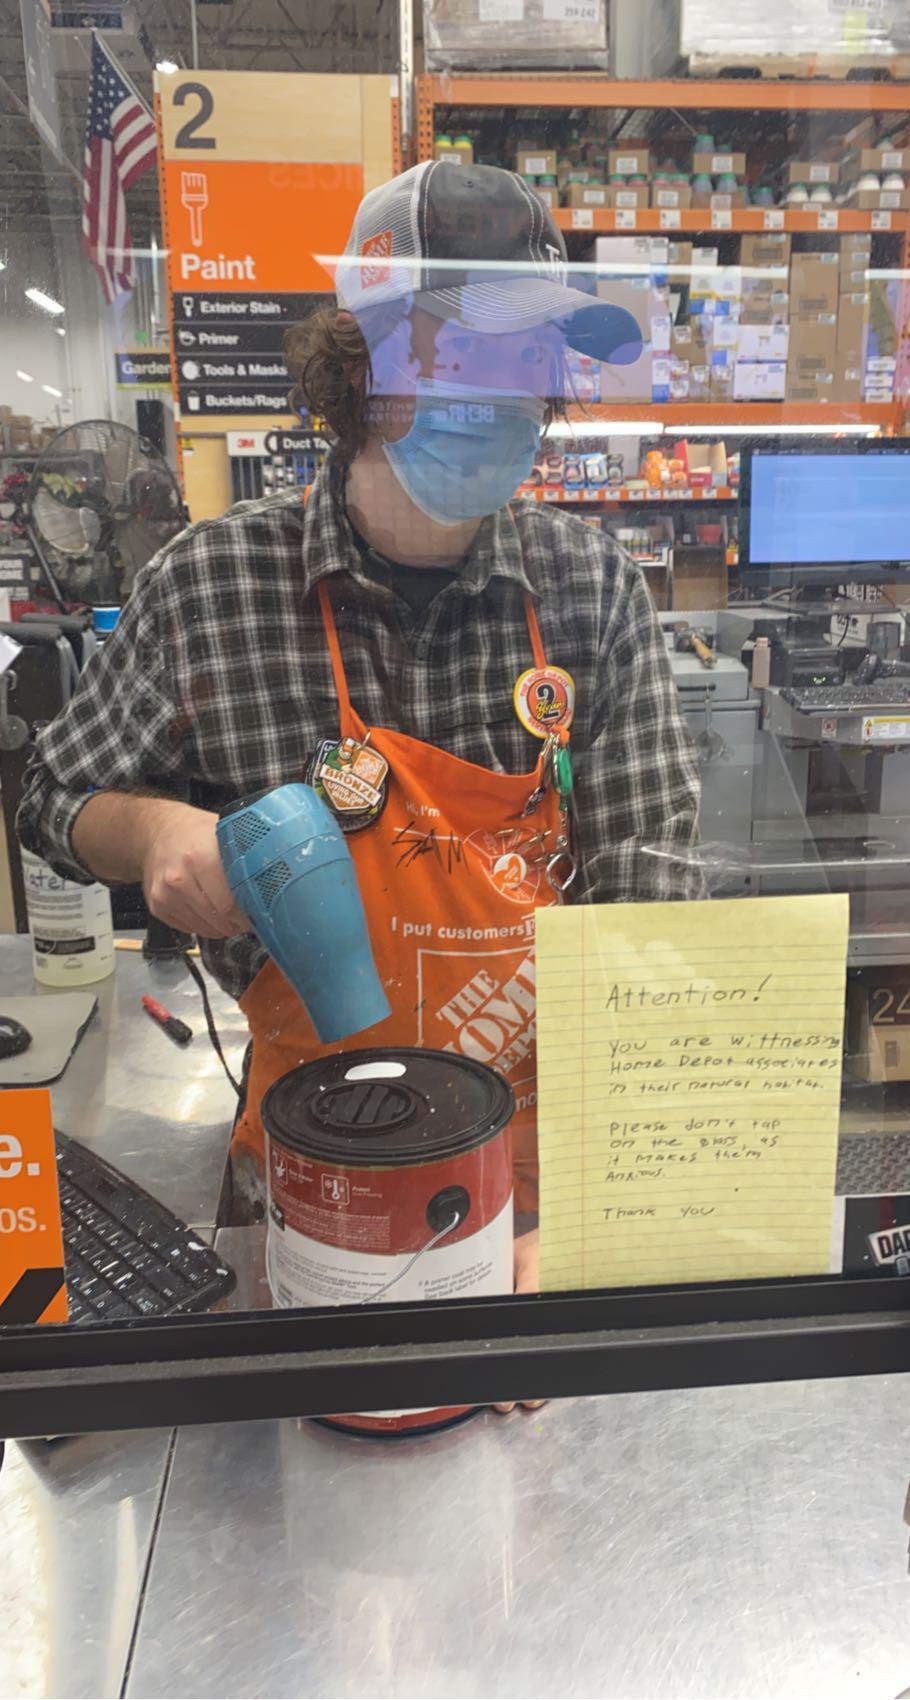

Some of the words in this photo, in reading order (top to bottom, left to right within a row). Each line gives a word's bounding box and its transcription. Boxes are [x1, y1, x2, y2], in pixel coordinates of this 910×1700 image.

[172, 81, 217, 150] 2
[180, 253, 256, 281] Paint
[200, 301, 248, 314] Exterior
[249, 301, 281, 314] Stain
[198, 332, 239, 345] Primer
[203, 364, 235, 376] Tools
[237, 364, 246, 376] &
[248, 364, 288, 376] Masks
[205, 395, 287, 409] Buckets/Rags
[236, 438, 256, 449] 3M
[283, 438, 311, 449] Duct
[420, 805, 440, 817] I'm
[391, 917, 397, 931] I
[403, 922, 432, 937] put
[437, 923, 526, 940] customers
[435, 968, 500, 1030] THE
[605, 973, 773, 1013] Attention!
[669, 1035, 713, 1048] are
[611, 1057, 665, 1075] Home
[608, 1081, 627, 1095] in
[640, 1080, 681, 1092] their
[688, 1079, 751, 1092] natural
[752, 1118, 782, 1130] tap
[609, 1139, 636, 1149] on
[651, 1137, 683, 1148] the
[760, 1135, 781, 1148] as
[607, 1155, 620, 1167] it
[603, 1207, 657, 1221] Thank
